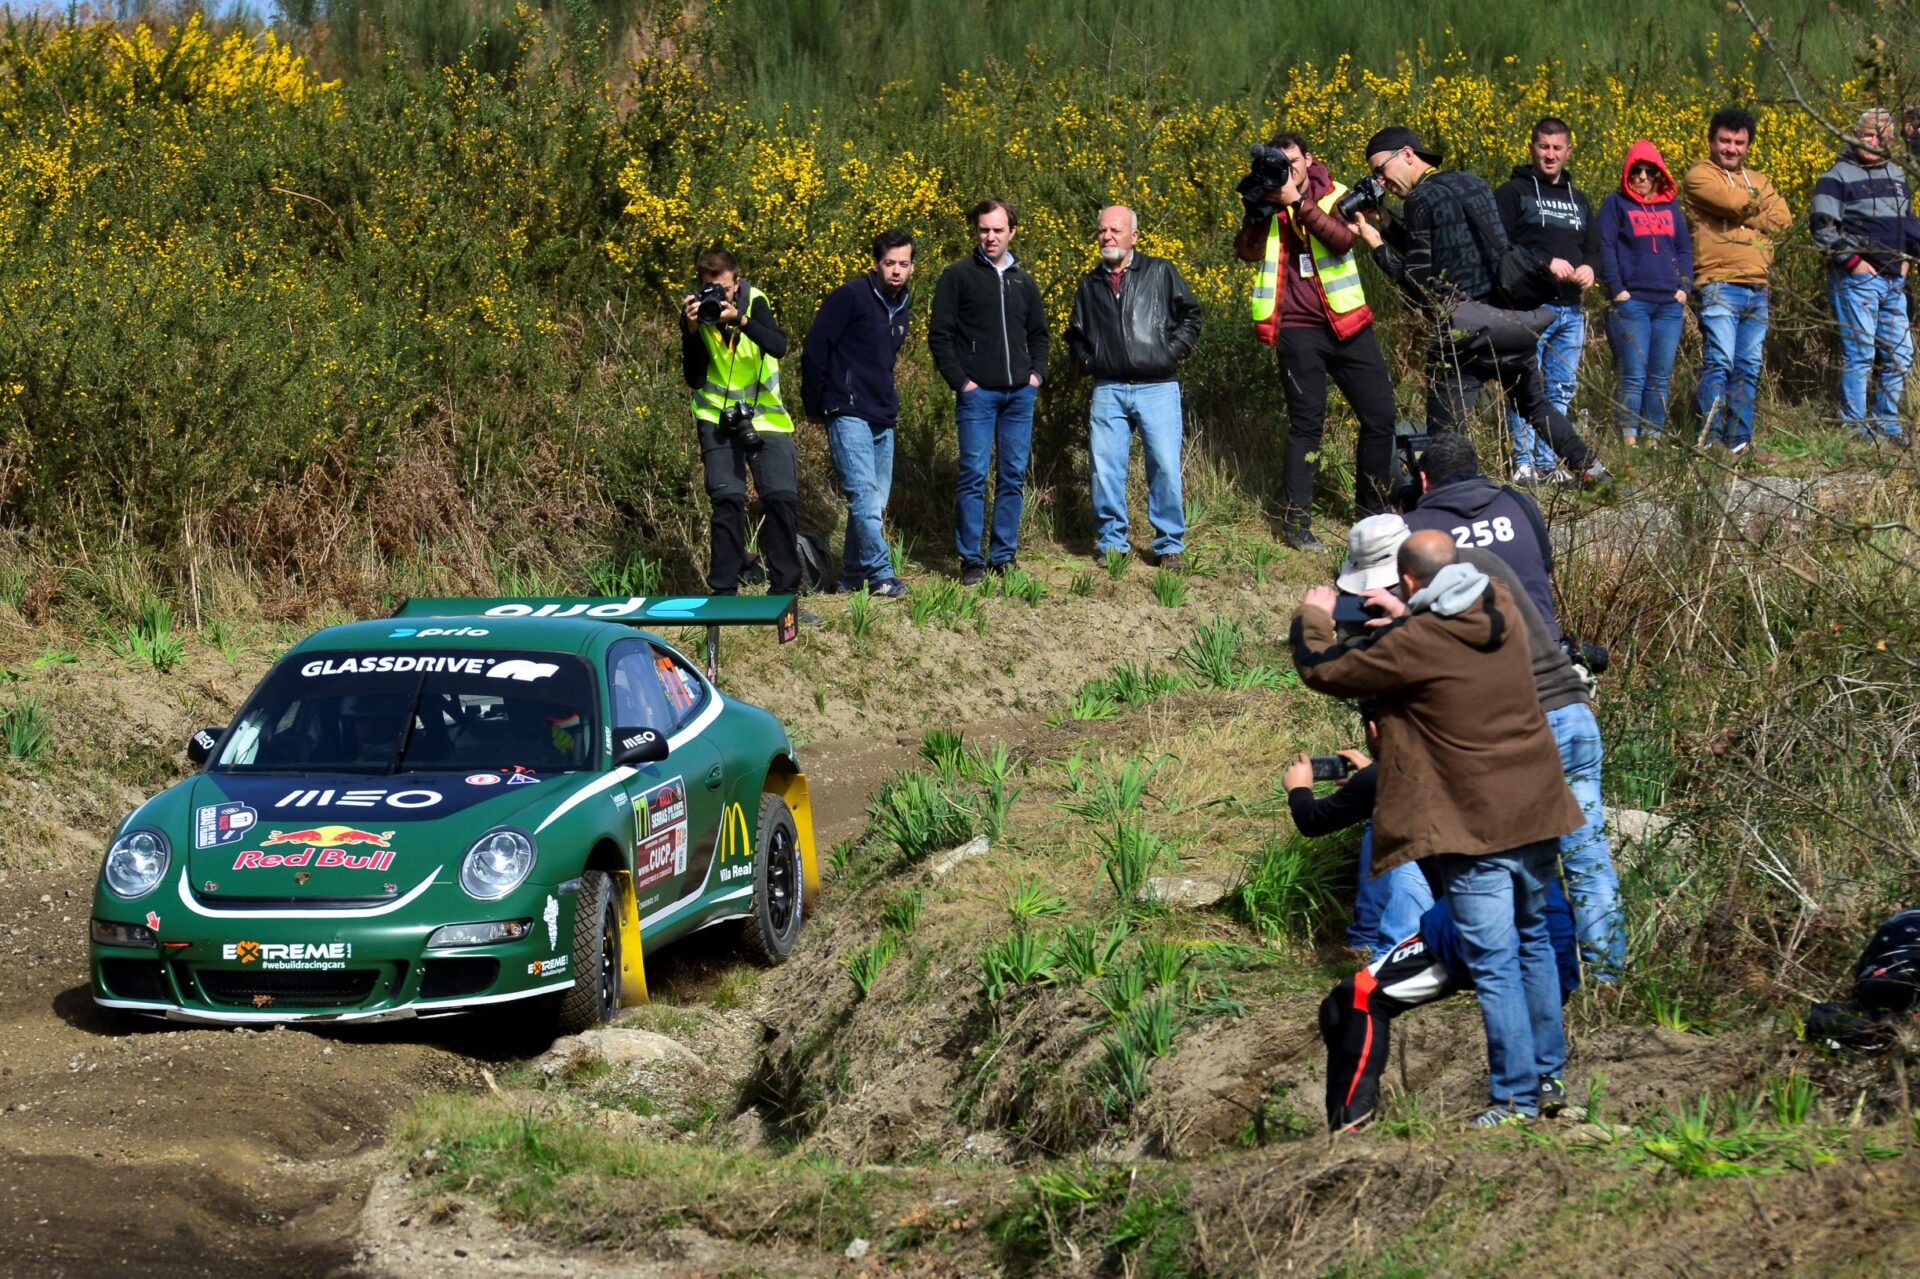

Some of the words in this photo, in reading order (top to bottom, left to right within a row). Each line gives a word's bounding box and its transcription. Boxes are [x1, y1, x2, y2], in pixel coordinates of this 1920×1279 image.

[1451, 516, 1515, 548] 258
[416, 626, 490, 638] prio
[193, 730, 215, 750] MEO
[622, 731, 656, 750] MEO
[274, 789, 443, 809] MEO
[232, 848, 315, 870] Red
[315, 848, 397, 871] Bull
[732, 862, 752, 878] Real
[223, 942, 345, 963] EXTREME
[262, 961, 346, 971] #webuildracingcars
[528, 955, 566, 976] EXTREME
